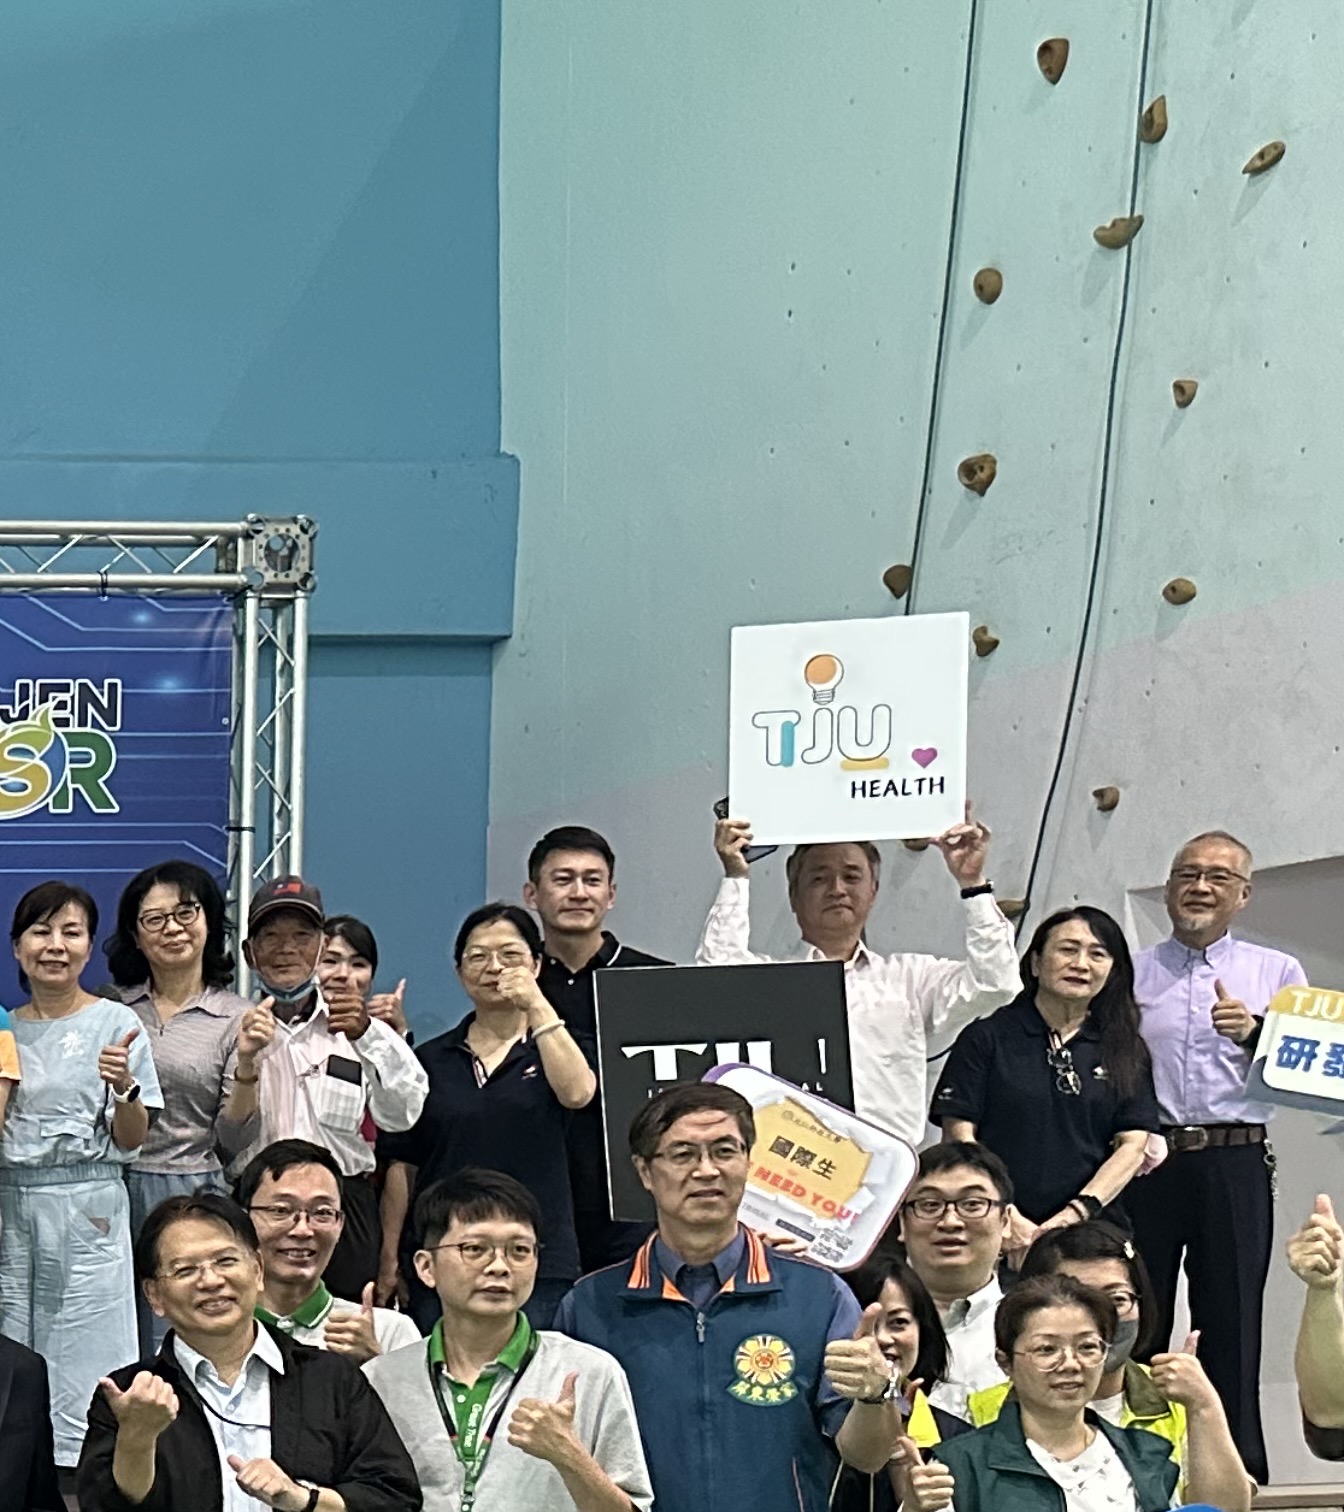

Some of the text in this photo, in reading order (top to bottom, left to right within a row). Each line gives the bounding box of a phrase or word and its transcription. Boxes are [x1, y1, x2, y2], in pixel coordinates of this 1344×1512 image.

[752, 703, 892, 768] TJU
[850, 775, 945, 799] HEALTH
[1290, 990, 1344, 1020] TJU
[768, 1135, 837, 1181] 國際生
[754, 1166, 807, 1198] NEED
